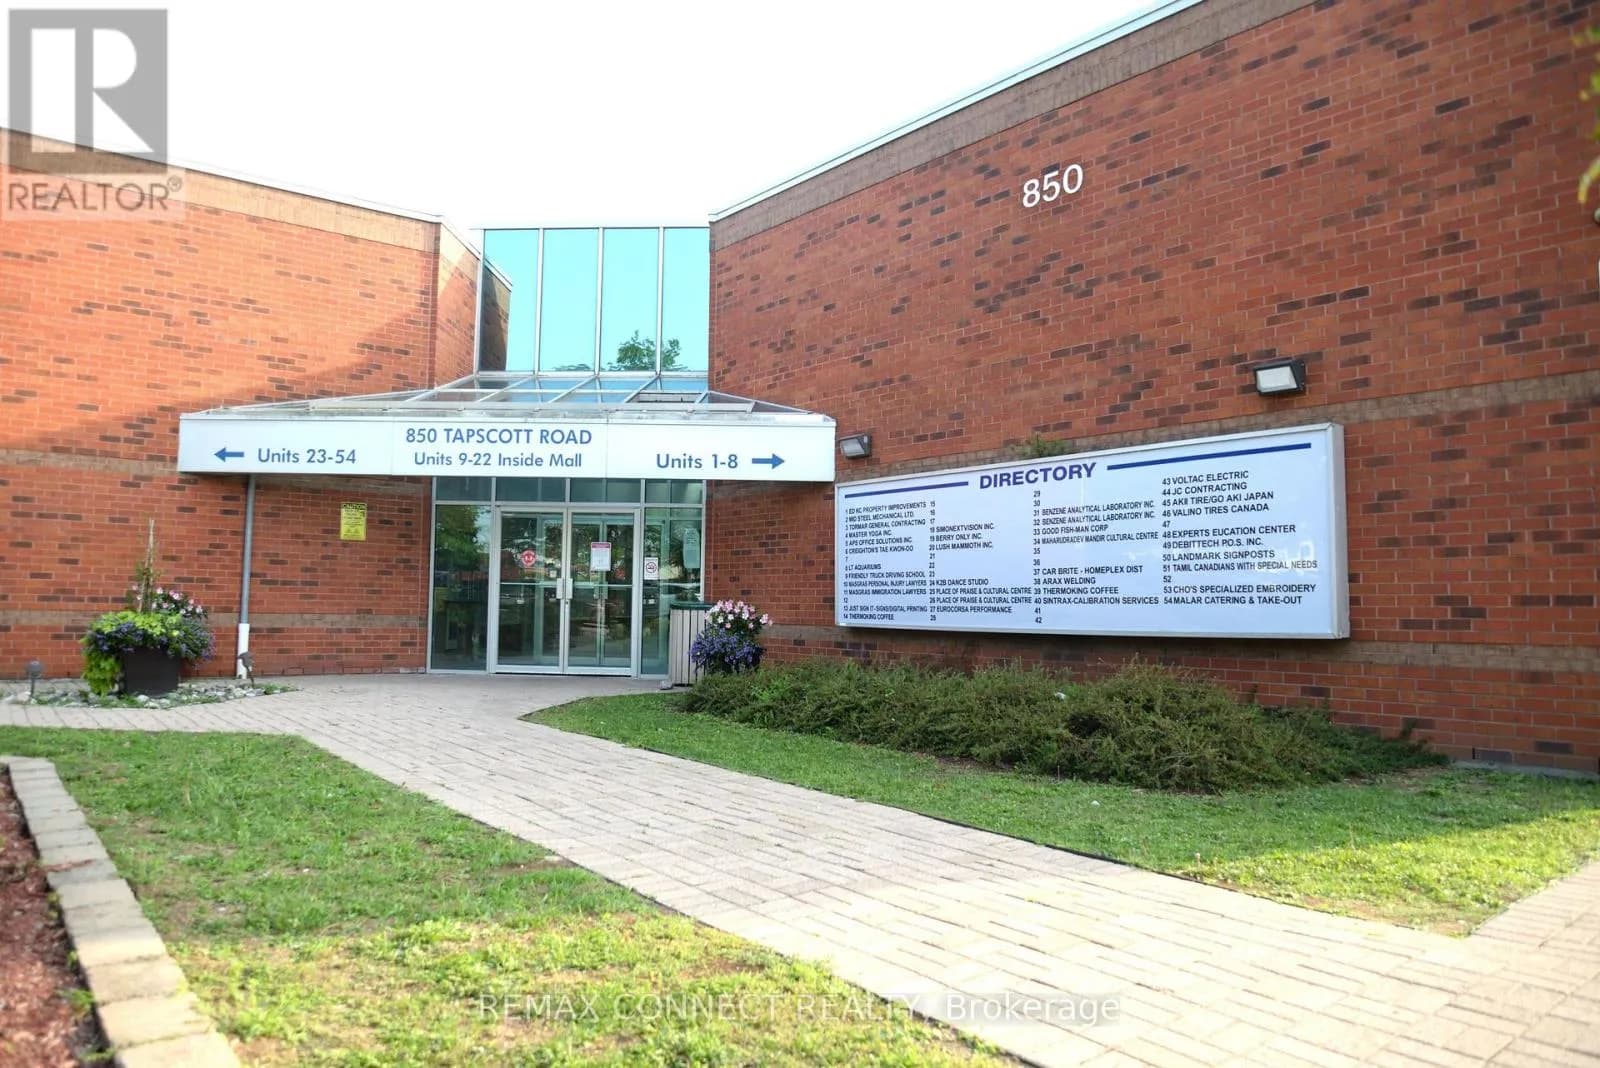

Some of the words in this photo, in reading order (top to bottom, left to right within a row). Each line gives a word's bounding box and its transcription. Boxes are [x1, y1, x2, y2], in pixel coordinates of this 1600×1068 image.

[1023, 164, 1083, 208] 850
[406, 428, 437, 443] 850
[444, 428, 533, 444] TAPSCOTT
[539, 429, 592, 445] ROAD
[258, 448, 300, 463] Units
[306, 448, 356, 464] 23-54
[414, 452, 452, 466] Units
[458, 452, 492, 466] 9-22
[498, 453, 544, 467] Inside
[549, 453, 582, 467] Mall
[656, 453, 702, 469] Units
[712, 454, 738, 469] 1-8
[980, 462, 1096, 489] DIRECTORY
[1172, 474, 1203, 485] VOLTAC
[1206, 470, 1249, 482] ELECTRIC
[1172, 487, 1182, 496] JC
[1185, 482, 1247, 494] CONTRACTING
[1191, 495, 1224, 505] TIRE/GO
[1227, 493, 1242, 502] AKI
[1244, 491, 1274, 501] JAPAN
[863, 504, 886, 513] PROPERTY
[1042, 507, 1066, 515] BENZENE
[1068, 506, 1101, 514] ANALYTICAL
[1103, 502, 1142, 511] LABORATORY
[1172, 508, 1202, 517] VALINO
[1204, 505, 1228, 515] TIRES
[1231, 503, 1269, 513] CANADA
[873, 512, 903, 520] MECHANICAL
[1068, 515, 1101, 524] ANALYTICAL
[1103, 512, 1142, 522] LABORATORY
[1061, 526, 1089, 534] FISH-MAN
[1172, 529, 1210, 538] EXPERTS
[1212, 527, 1256, 536] EUCATION
[1259, 524, 1296, 534] CENTER
[1106, 533, 1135, 542] CULTURAL
[1136, 532, 1158, 540] CENTRE
[1172, 539, 1219, 549] DEBITTECH
[1246, 537, 1264, 546] INC.
[1172, 552, 1221, 561] LANDMARK
[1223, 550, 1275, 559] SIGNPOSTS
[1084, 565, 1124, 574] HOMEPLEX
[1126, 565, 1143, 573] DIST
[1194, 562, 1235, 571] CANADIANS
[1237, 562, 1255, 570] WITH
[1257, 561, 1288, 569] SPECIAL
[1291, 560, 1317, 568] NEEDS
[1200, 584, 1254, 593] SPECIALIZED
[1256, 584, 1316, 593] EMBROIDERY
[1204, 596, 1246, 604] CATERING
[1249, 596, 1254, 604] &
[1258, 595, 1302, 604] TAKE-OUT
